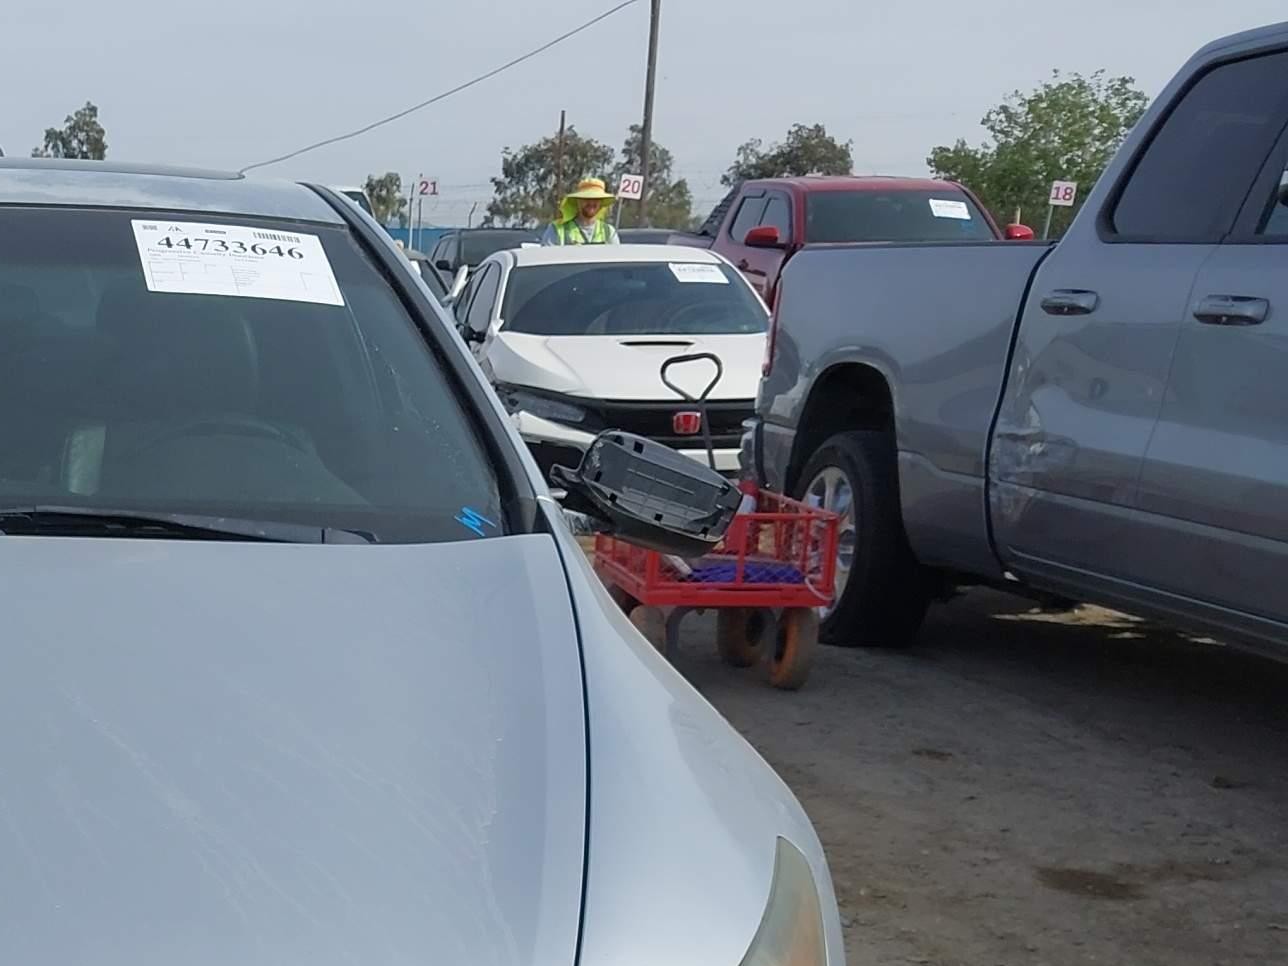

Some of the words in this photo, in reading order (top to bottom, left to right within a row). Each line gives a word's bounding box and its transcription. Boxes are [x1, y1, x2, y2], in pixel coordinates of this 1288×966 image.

[419, 180, 439, 195] 21
[622, 178, 641, 194] 20
[1052, 186, 1074, 201] 18
[157, 236, 304, 260] 44733646
